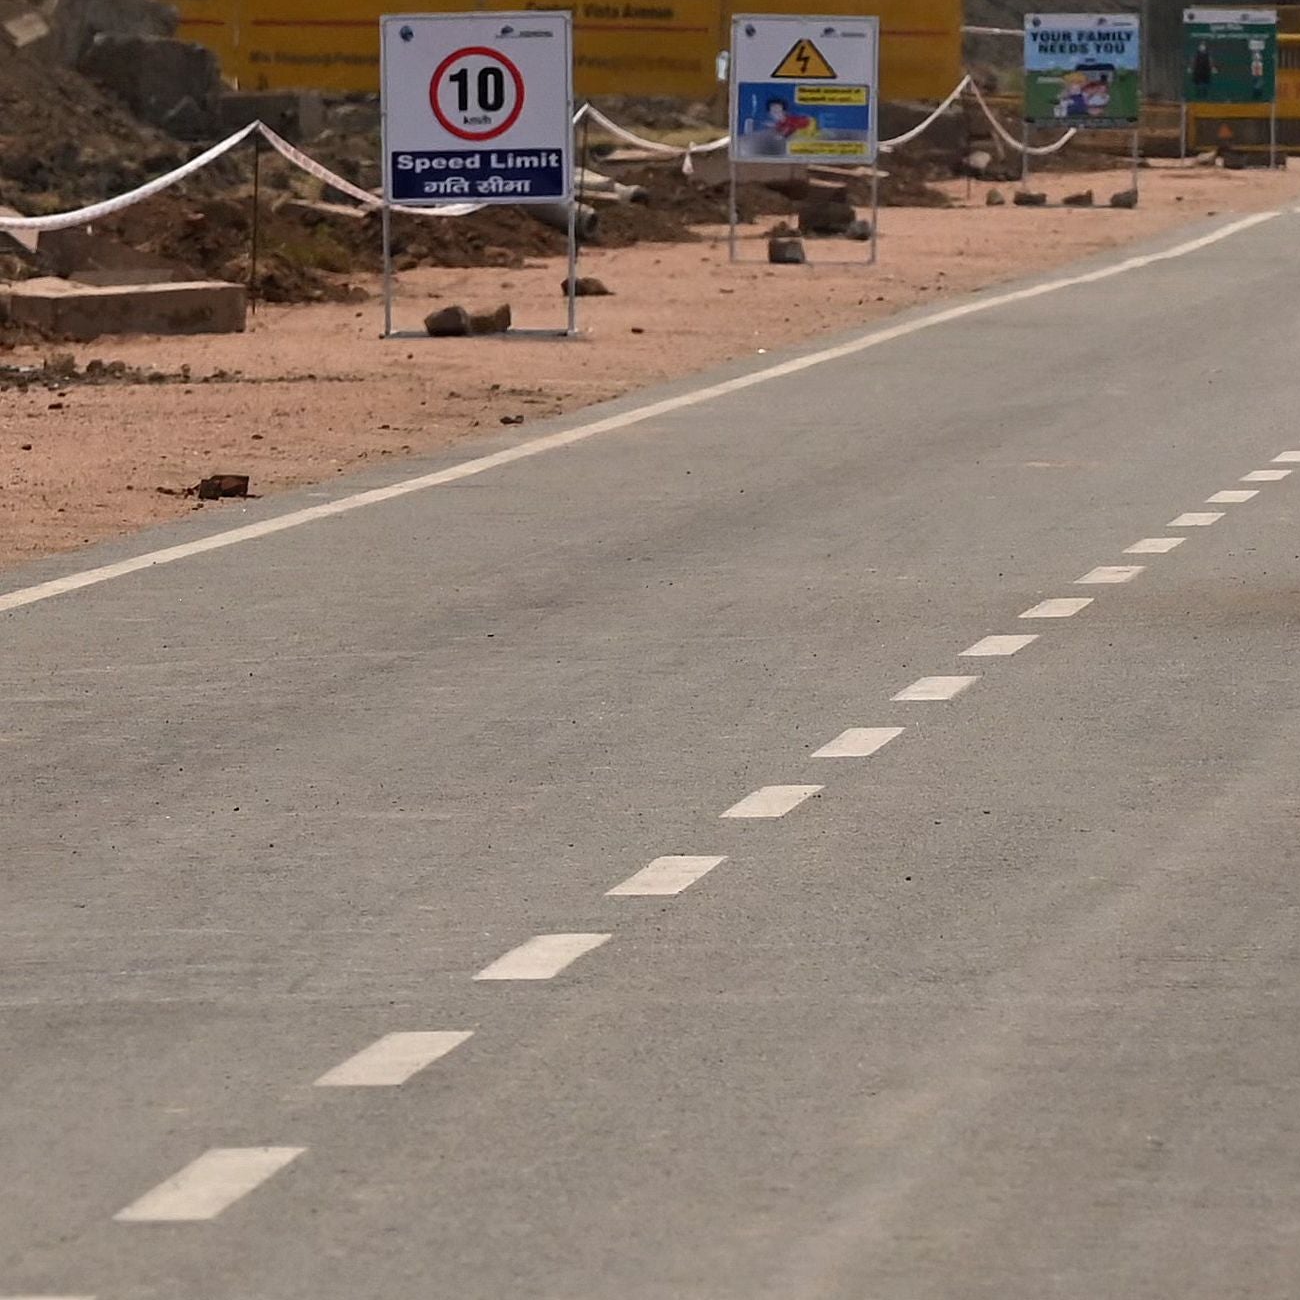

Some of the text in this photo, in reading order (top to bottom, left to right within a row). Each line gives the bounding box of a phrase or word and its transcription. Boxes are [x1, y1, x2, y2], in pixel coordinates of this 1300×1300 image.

[1030, 31, 1133, 42] YOUR FAMILY
[1038, 42, 1125, 54] NEEDS YOU
[449, 67, 505, 112] 10
[463, 115, 492, 125] km/h
[397, 152, 560, 174] Speed Limit
[424, 175, 531, 194] गति सीमा
